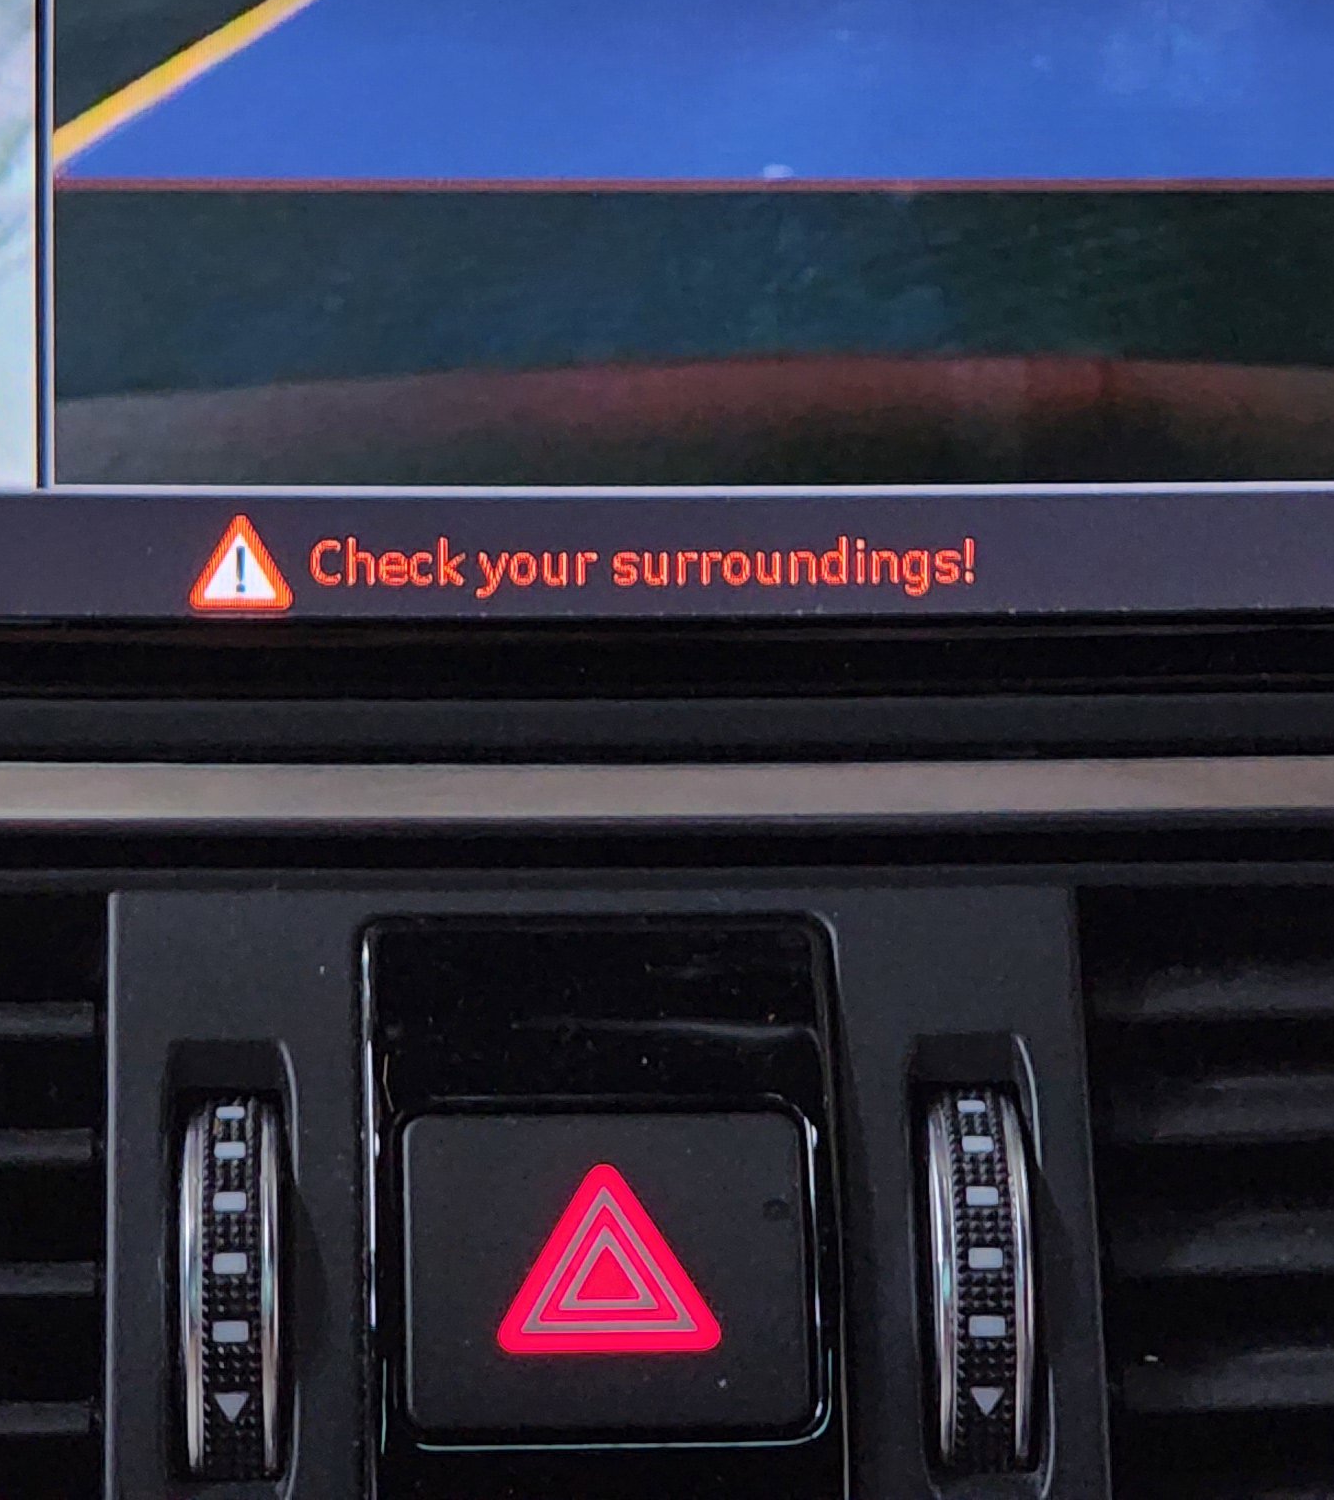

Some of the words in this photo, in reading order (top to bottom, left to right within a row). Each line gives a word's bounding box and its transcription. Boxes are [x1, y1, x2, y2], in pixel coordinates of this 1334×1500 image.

[310, 536, 466, 587] Check
[476, 548, 598, 599] your
[612, 536, 976, 597] surroundings!
